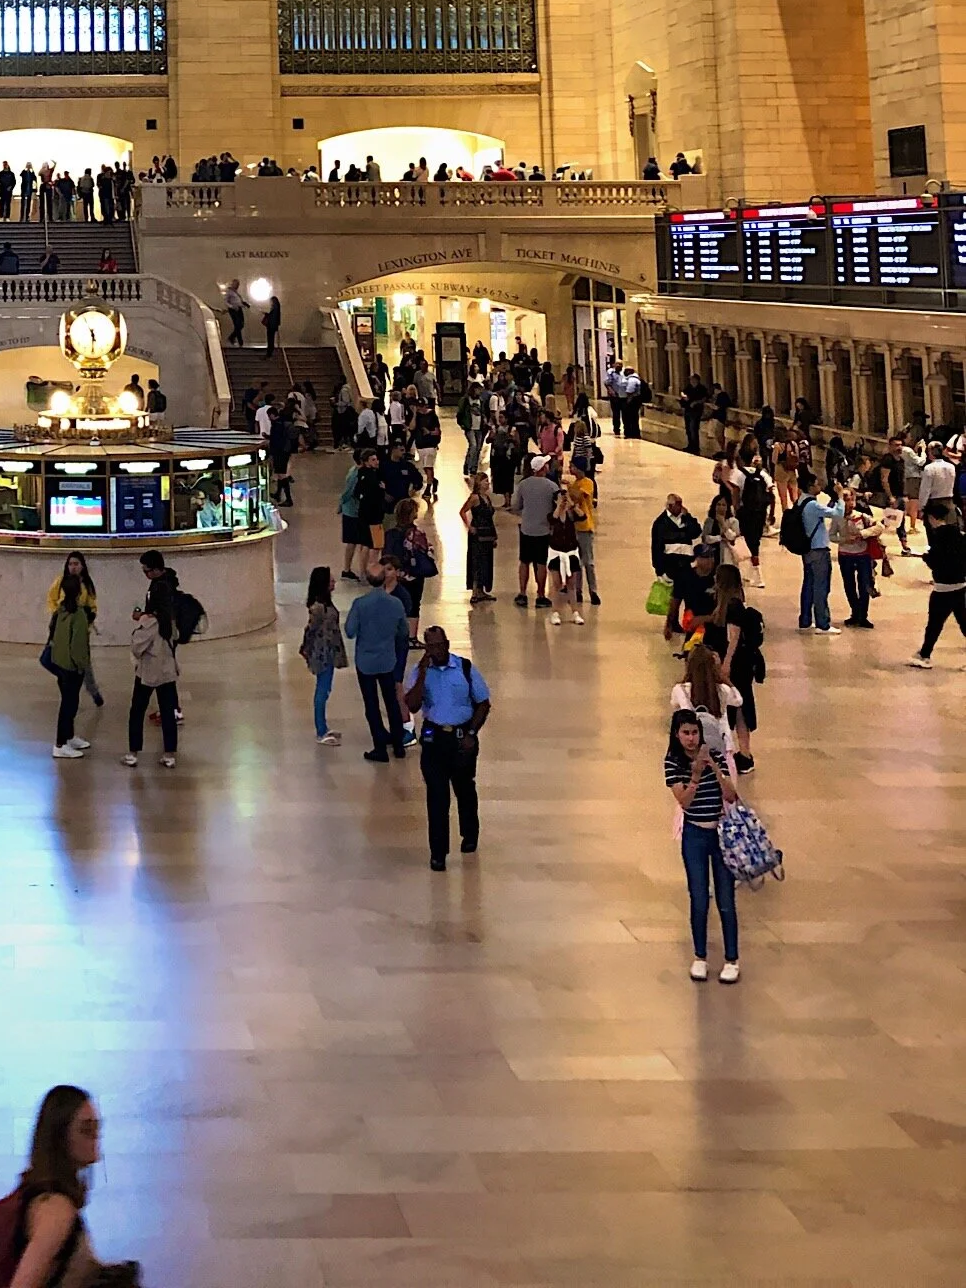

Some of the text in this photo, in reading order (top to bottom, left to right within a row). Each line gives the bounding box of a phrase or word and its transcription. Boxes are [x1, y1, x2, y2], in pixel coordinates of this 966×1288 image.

[225, 251, 290, 259] EAST BALCONY
[378, 248, 473, 272] LEXINGTON AVE
[515, 248, 621, 274] TICKET MACHINES
[344, 283, 379, 295] STREET
[384, 282, 425, 291] PASSAGE
[430, 283, 472, 292] SUBWAY
[8, 337, 19, 345] TO
